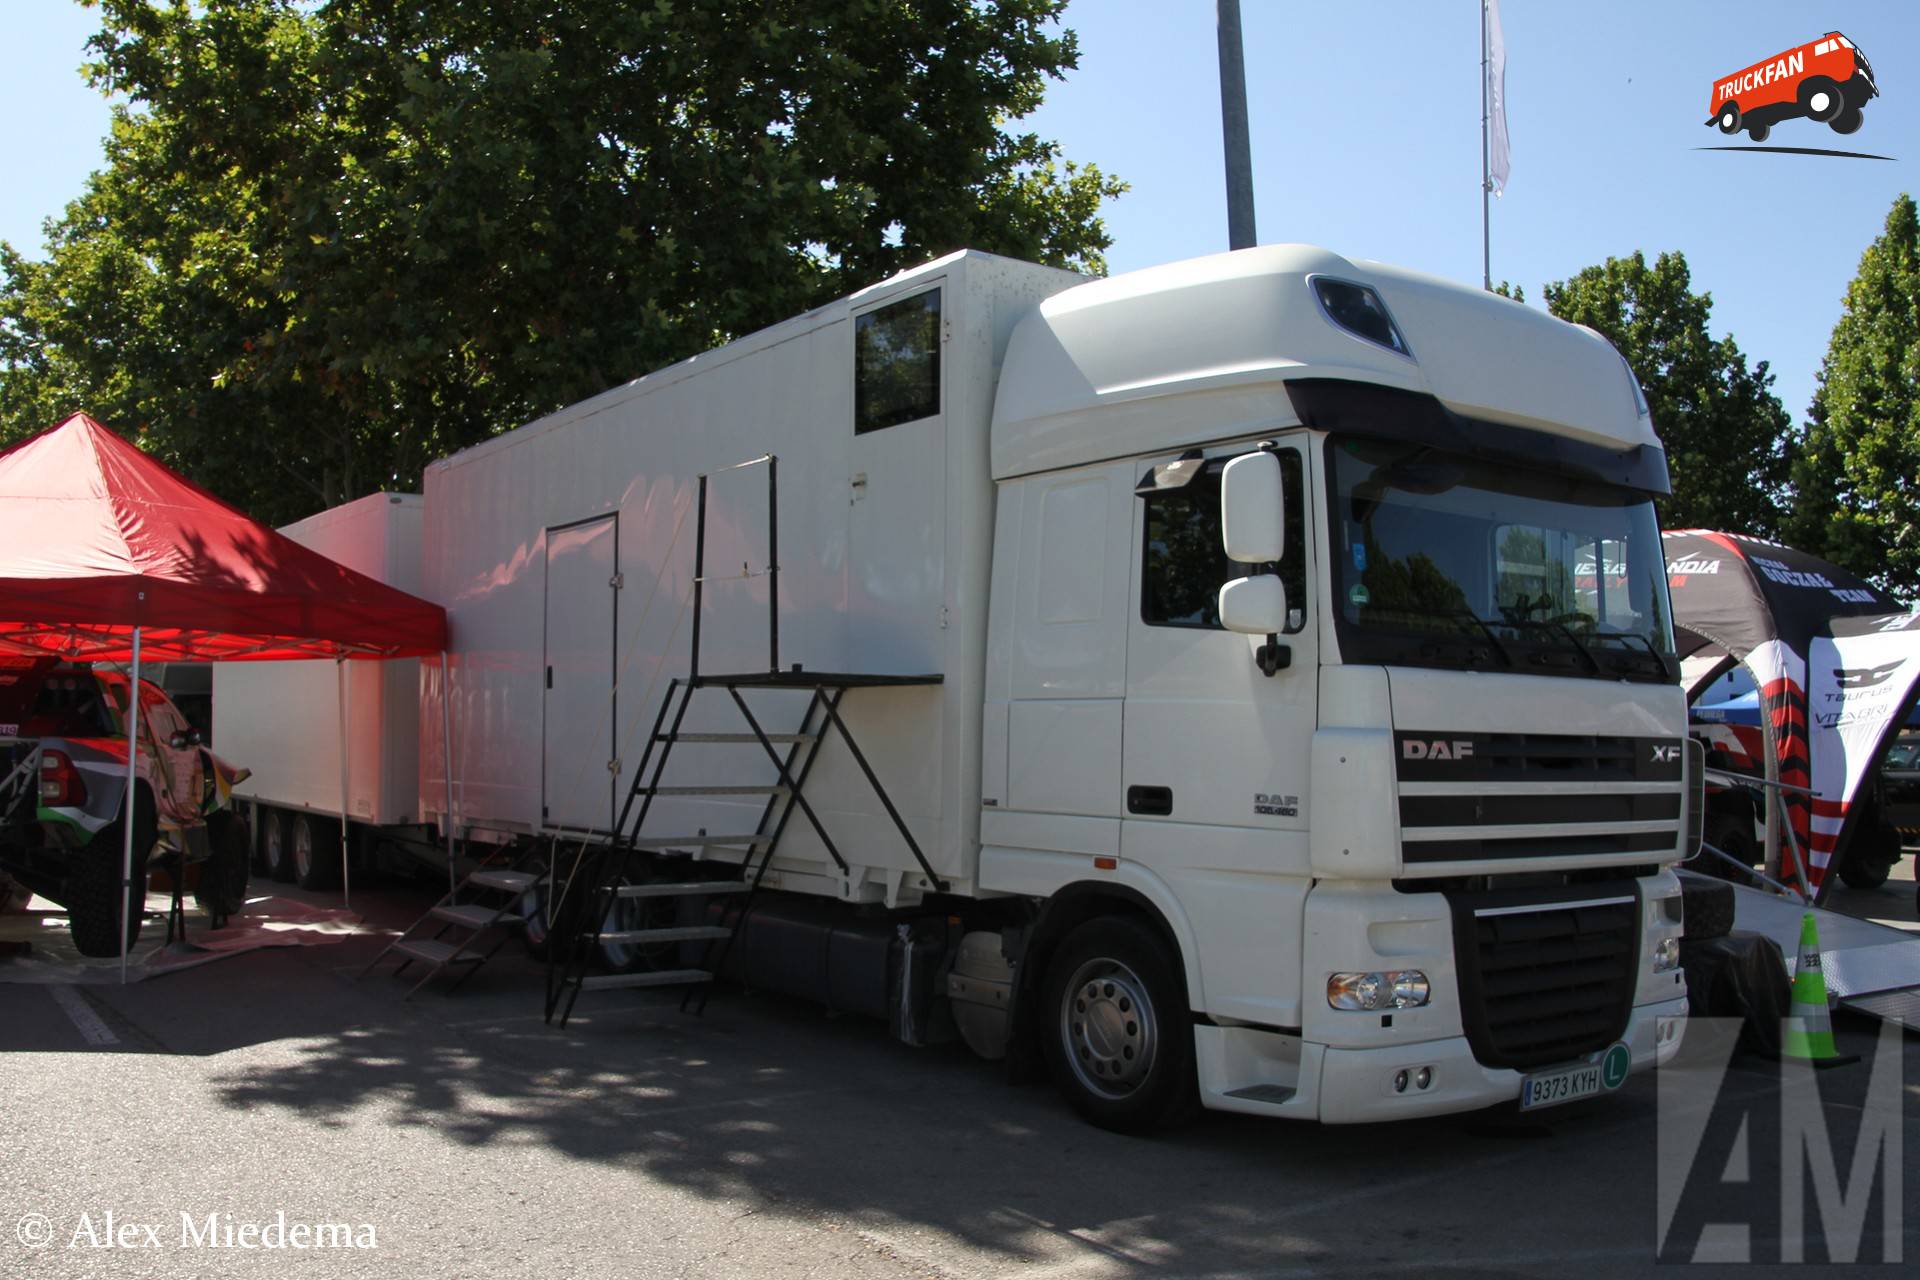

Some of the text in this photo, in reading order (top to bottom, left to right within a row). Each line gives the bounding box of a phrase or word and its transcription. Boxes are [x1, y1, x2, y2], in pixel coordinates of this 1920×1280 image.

[1403, 740, 1473, 760] DAF
[1651, 745, 1681, 762] XF
[1254, 793, 1298, 806] DAF
[1609, 1054, 1621, 1081] L
[1533, 1069, 1598, 1102] 9373 KYH
